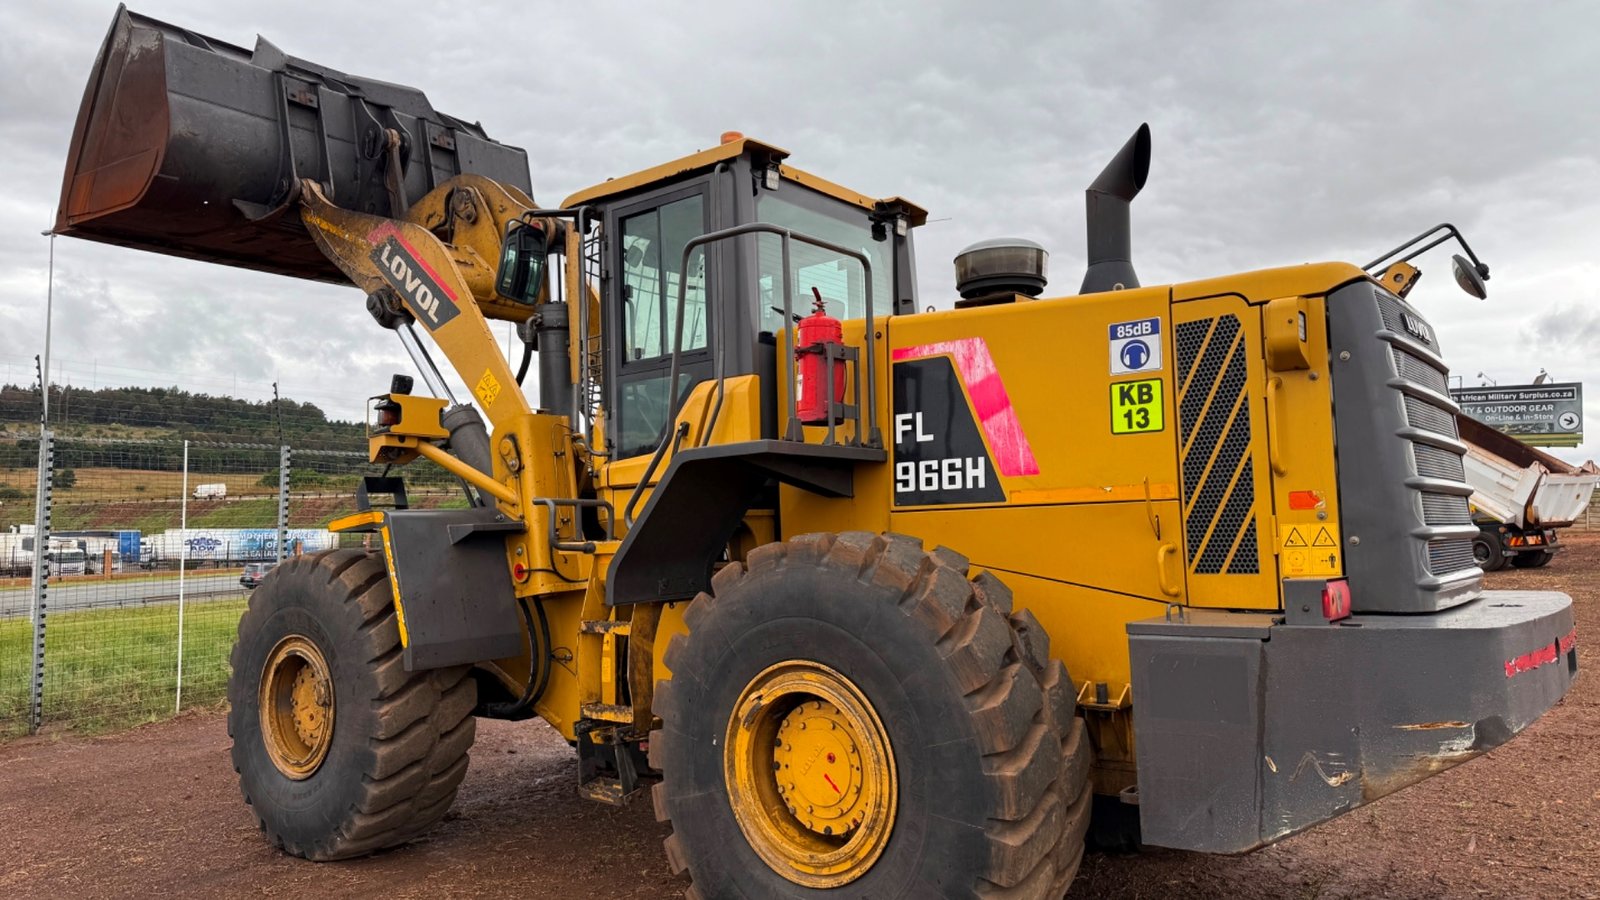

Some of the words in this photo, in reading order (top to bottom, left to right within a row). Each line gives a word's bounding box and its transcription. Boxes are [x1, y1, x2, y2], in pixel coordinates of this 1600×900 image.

[381, 243, 440, 324] LOVOL
[1117, 322, 1152, 338] 85dB
[1119, 383, 1154, 406] KB
[1488, 392, 1517, 400] Military
[1519, 391, 1573, 400] Surplus.co.za
[1123, 407, 1150, 429] 13
[1484, 404, 1527, 413] OUTDOOR
[895, 411, 934, 444] FL
[896, 456, 986, 493] 966H
